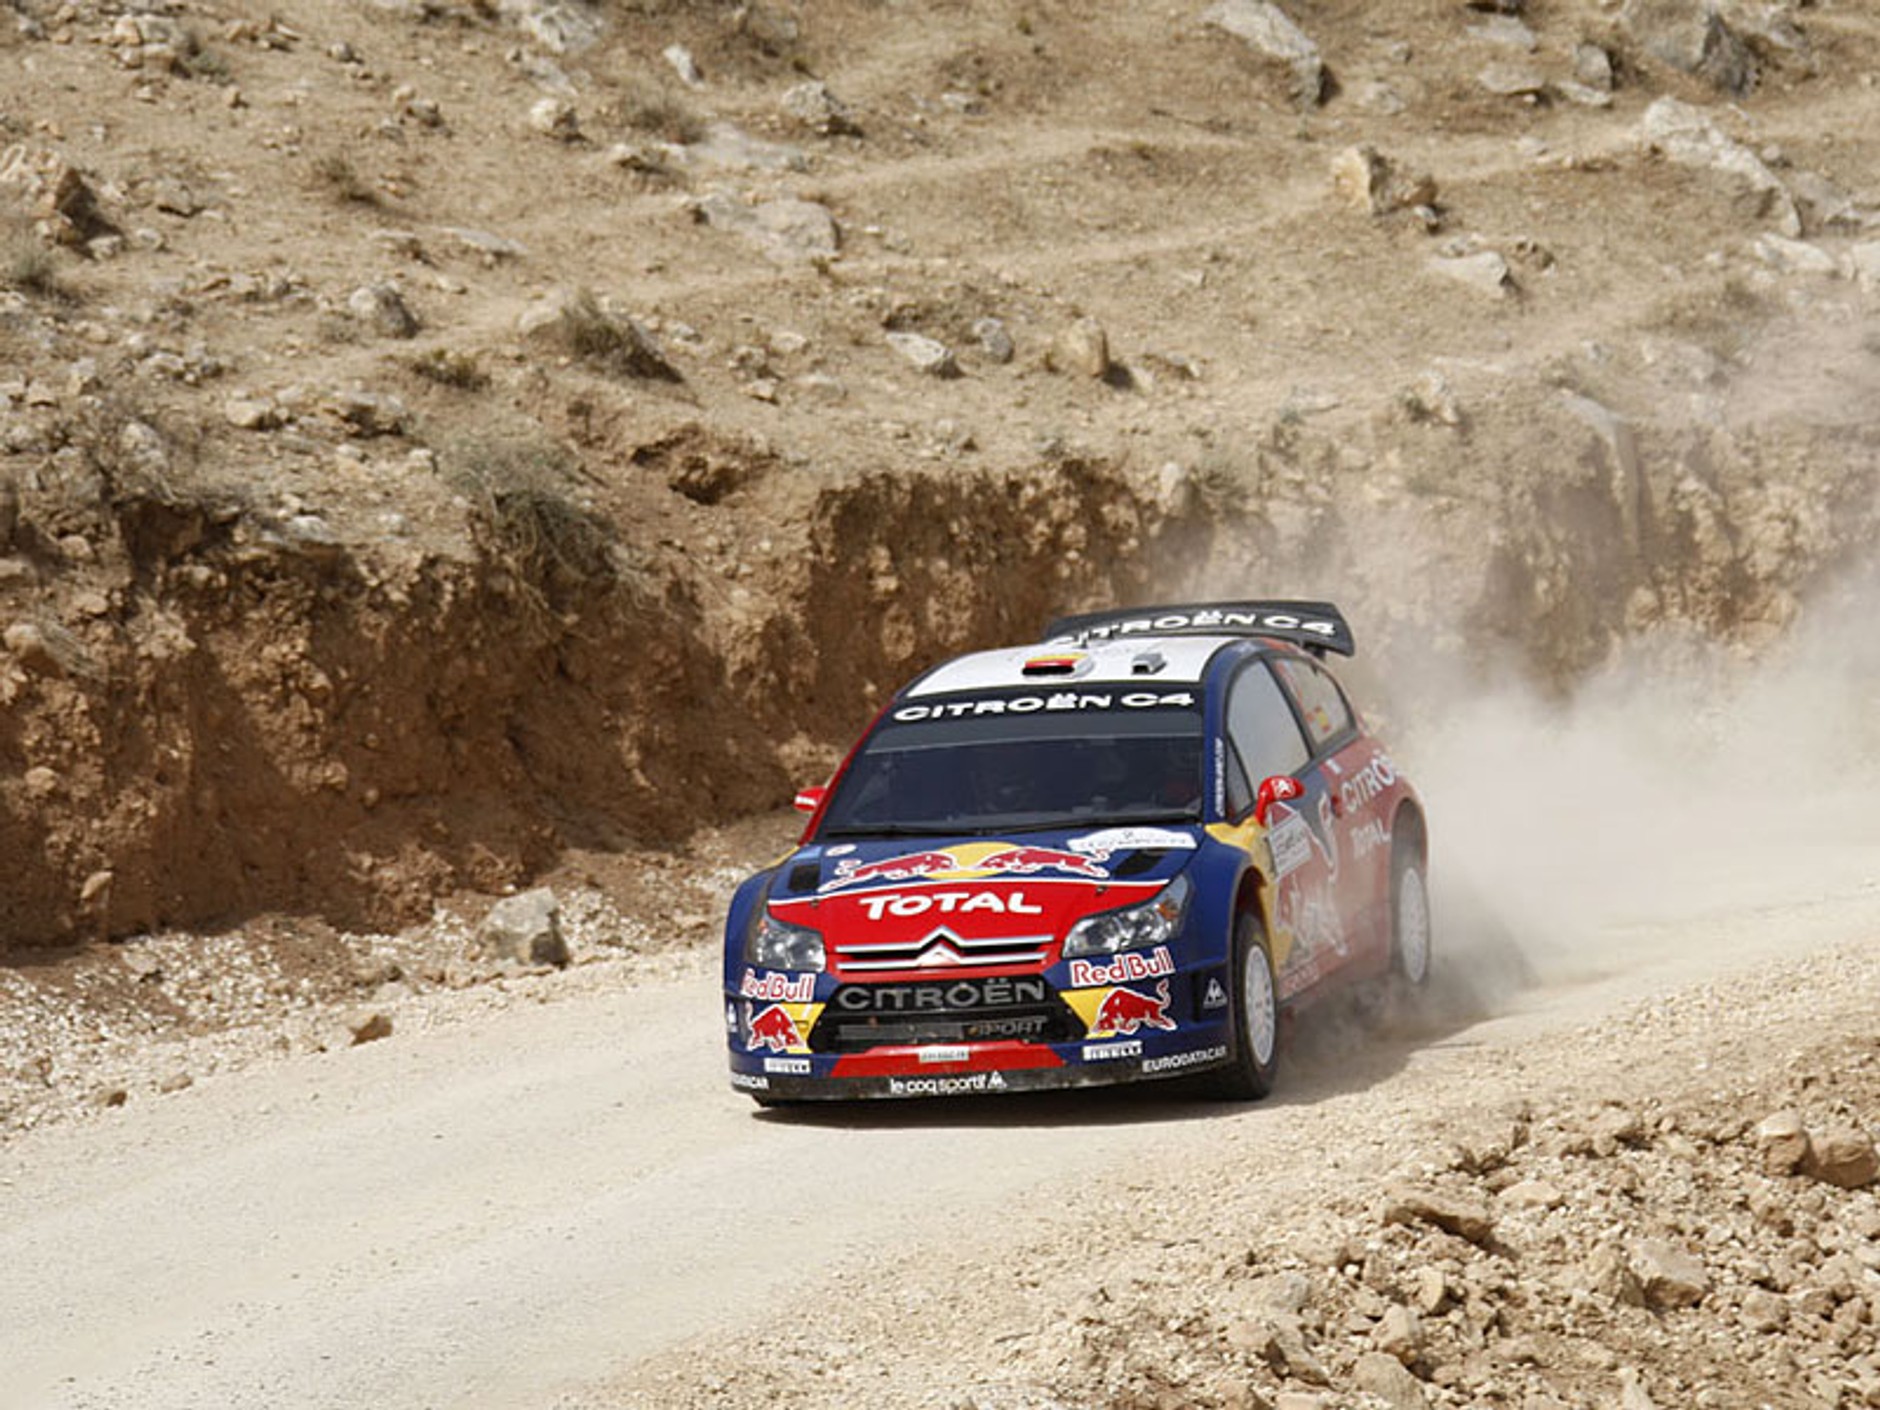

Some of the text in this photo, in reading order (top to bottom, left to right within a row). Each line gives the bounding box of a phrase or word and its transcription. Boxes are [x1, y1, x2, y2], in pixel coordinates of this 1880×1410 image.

[1264, 614, 1335, 636] C4
[1120, 692, 1195, 708] C4
[859, 891, 1042, 921] TOTAL
[890, 1073, 986, 1096] le coq sportif
